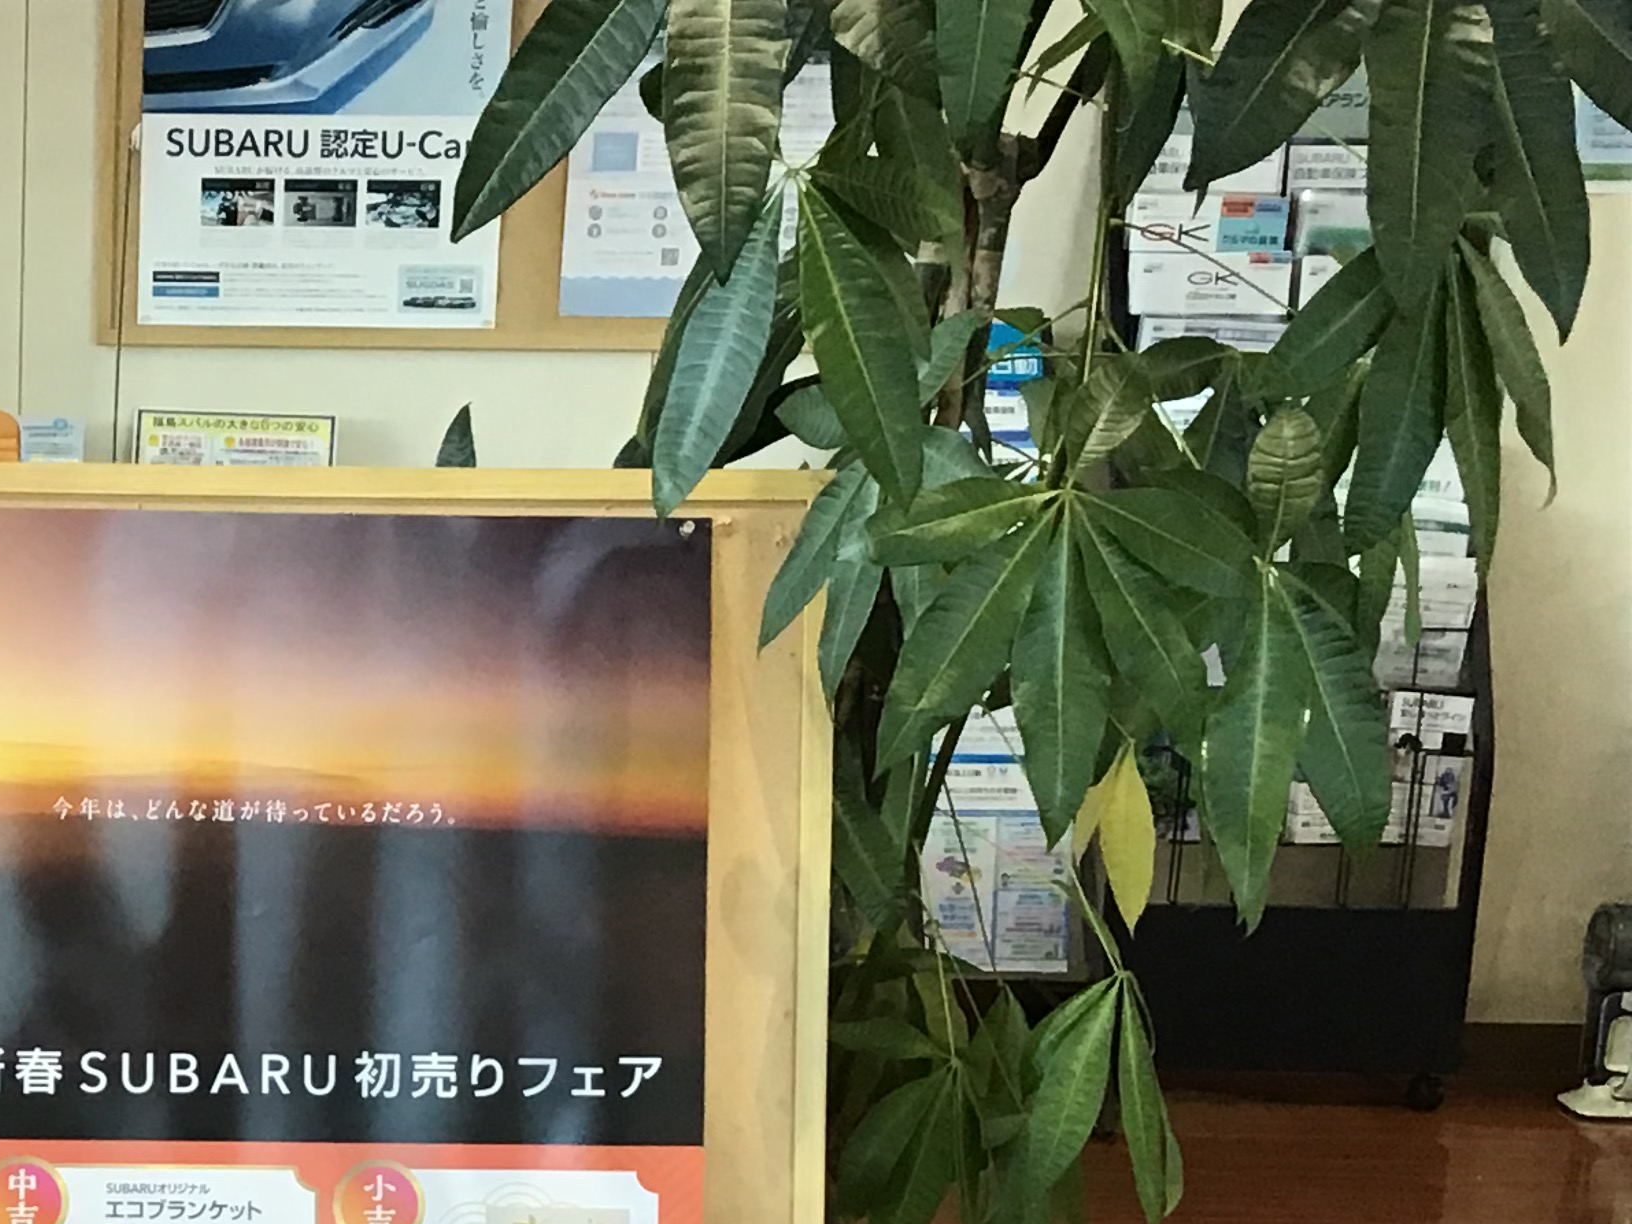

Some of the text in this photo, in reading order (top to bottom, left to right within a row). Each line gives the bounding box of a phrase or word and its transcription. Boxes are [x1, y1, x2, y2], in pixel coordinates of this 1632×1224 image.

[166, 127, 309, 158] SUBARU
[52, 795, 457, 826] 今年は、どんな道が待っているだろう。
[105, 1182, 211, 1195] SUBARUオリジナル
[105, 1200, 262, 1221] エコブランケット
